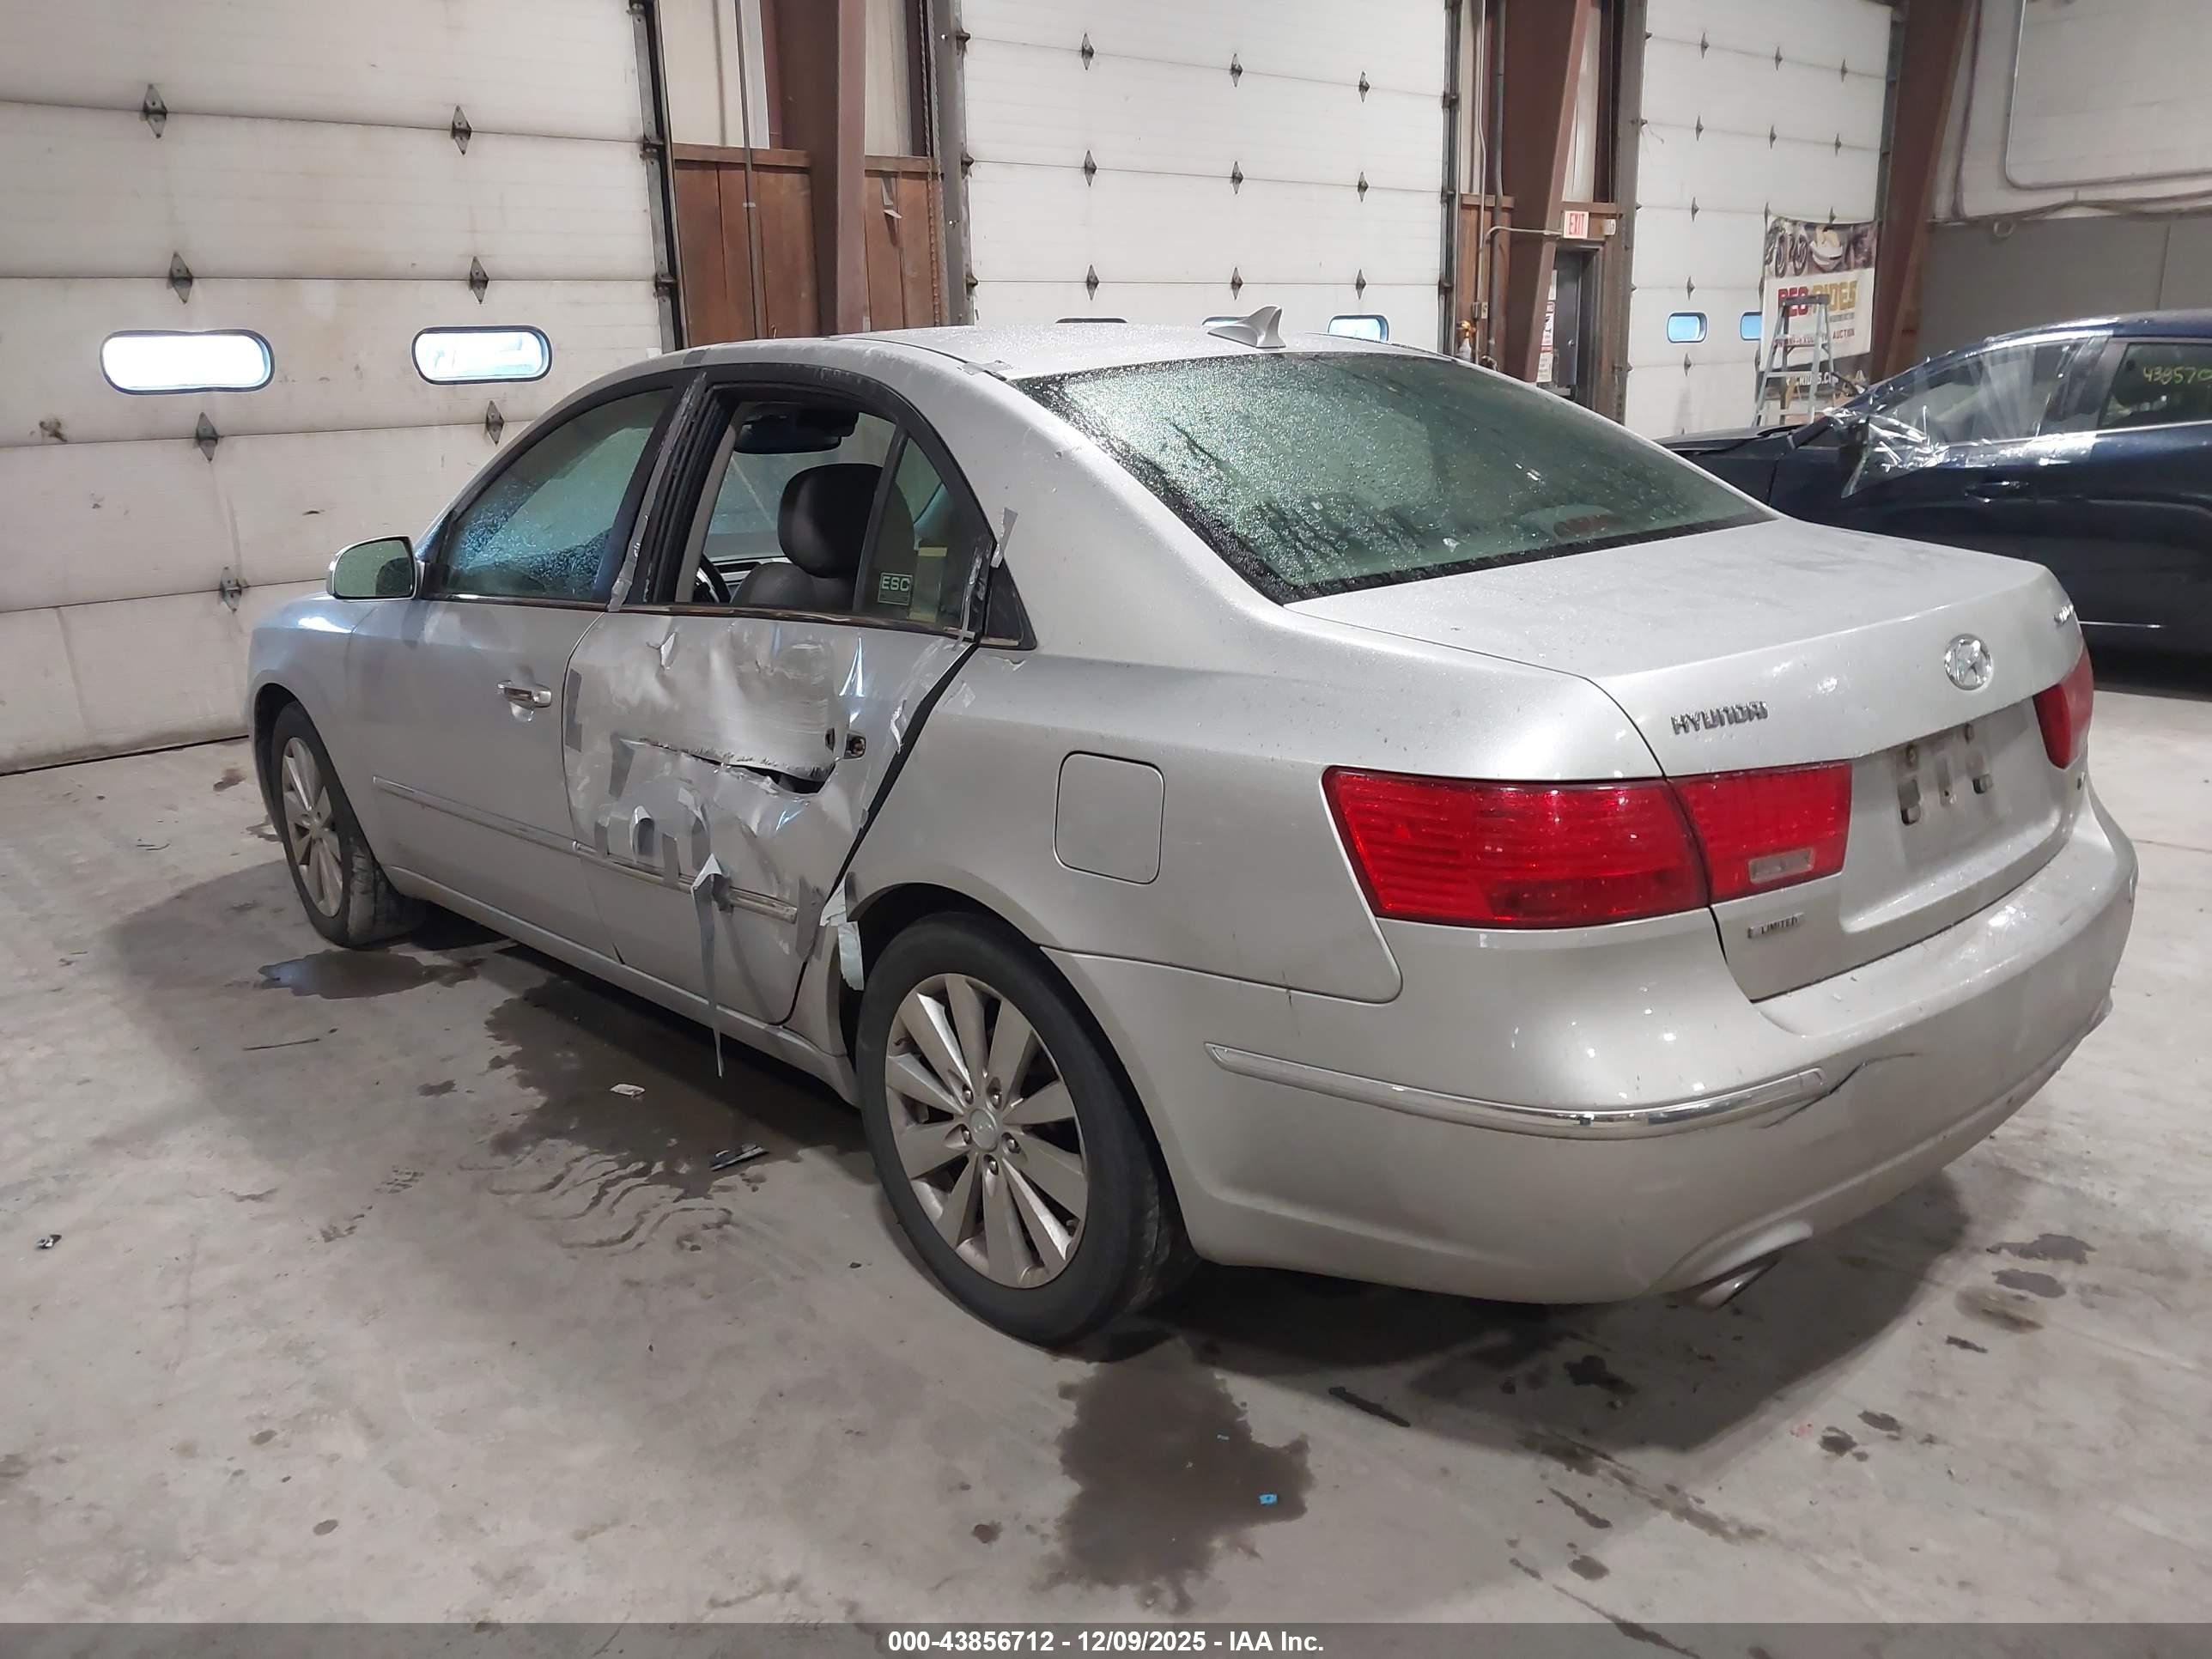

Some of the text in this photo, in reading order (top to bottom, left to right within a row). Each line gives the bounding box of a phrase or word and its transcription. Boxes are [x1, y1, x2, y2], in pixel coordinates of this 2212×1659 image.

[1569, 212, 1585, 235] EXIT
[1832, 328, 1855, 340] AUCTION
[880, 575, 911, 592] ESC
[1670, 701, 1769, 735] HYUNDAI
[1758, 914, 1801, 936] LIMITED
